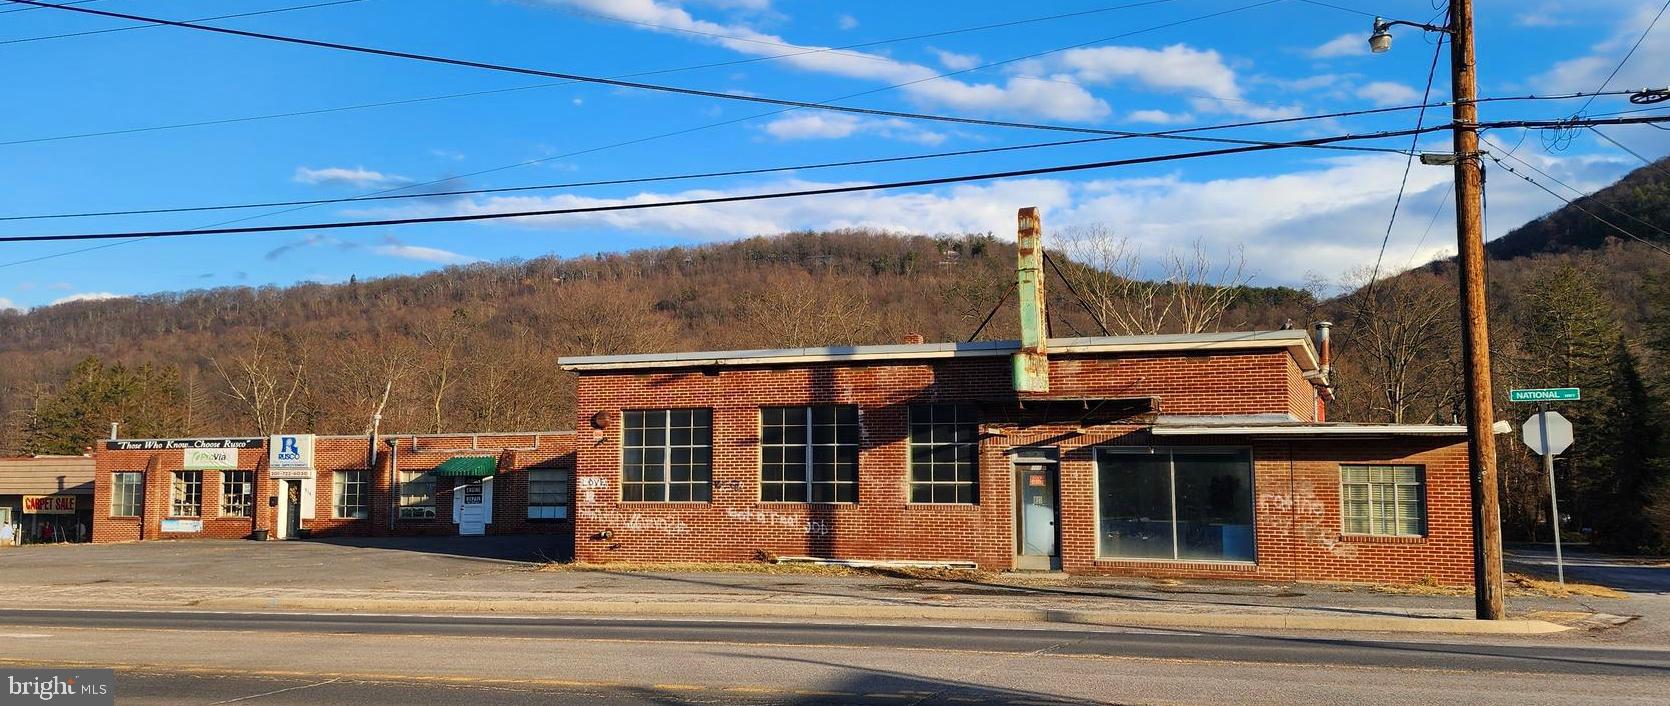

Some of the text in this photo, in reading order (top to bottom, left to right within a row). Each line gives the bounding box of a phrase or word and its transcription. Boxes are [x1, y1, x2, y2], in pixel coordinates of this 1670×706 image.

[1516, 391, 1560, 399] NATIONAL
[144, 441, 163, 449] Who
[278, 453, 300, 461] RUSCO
[25, 498, 74, 511] CARPET SALE
